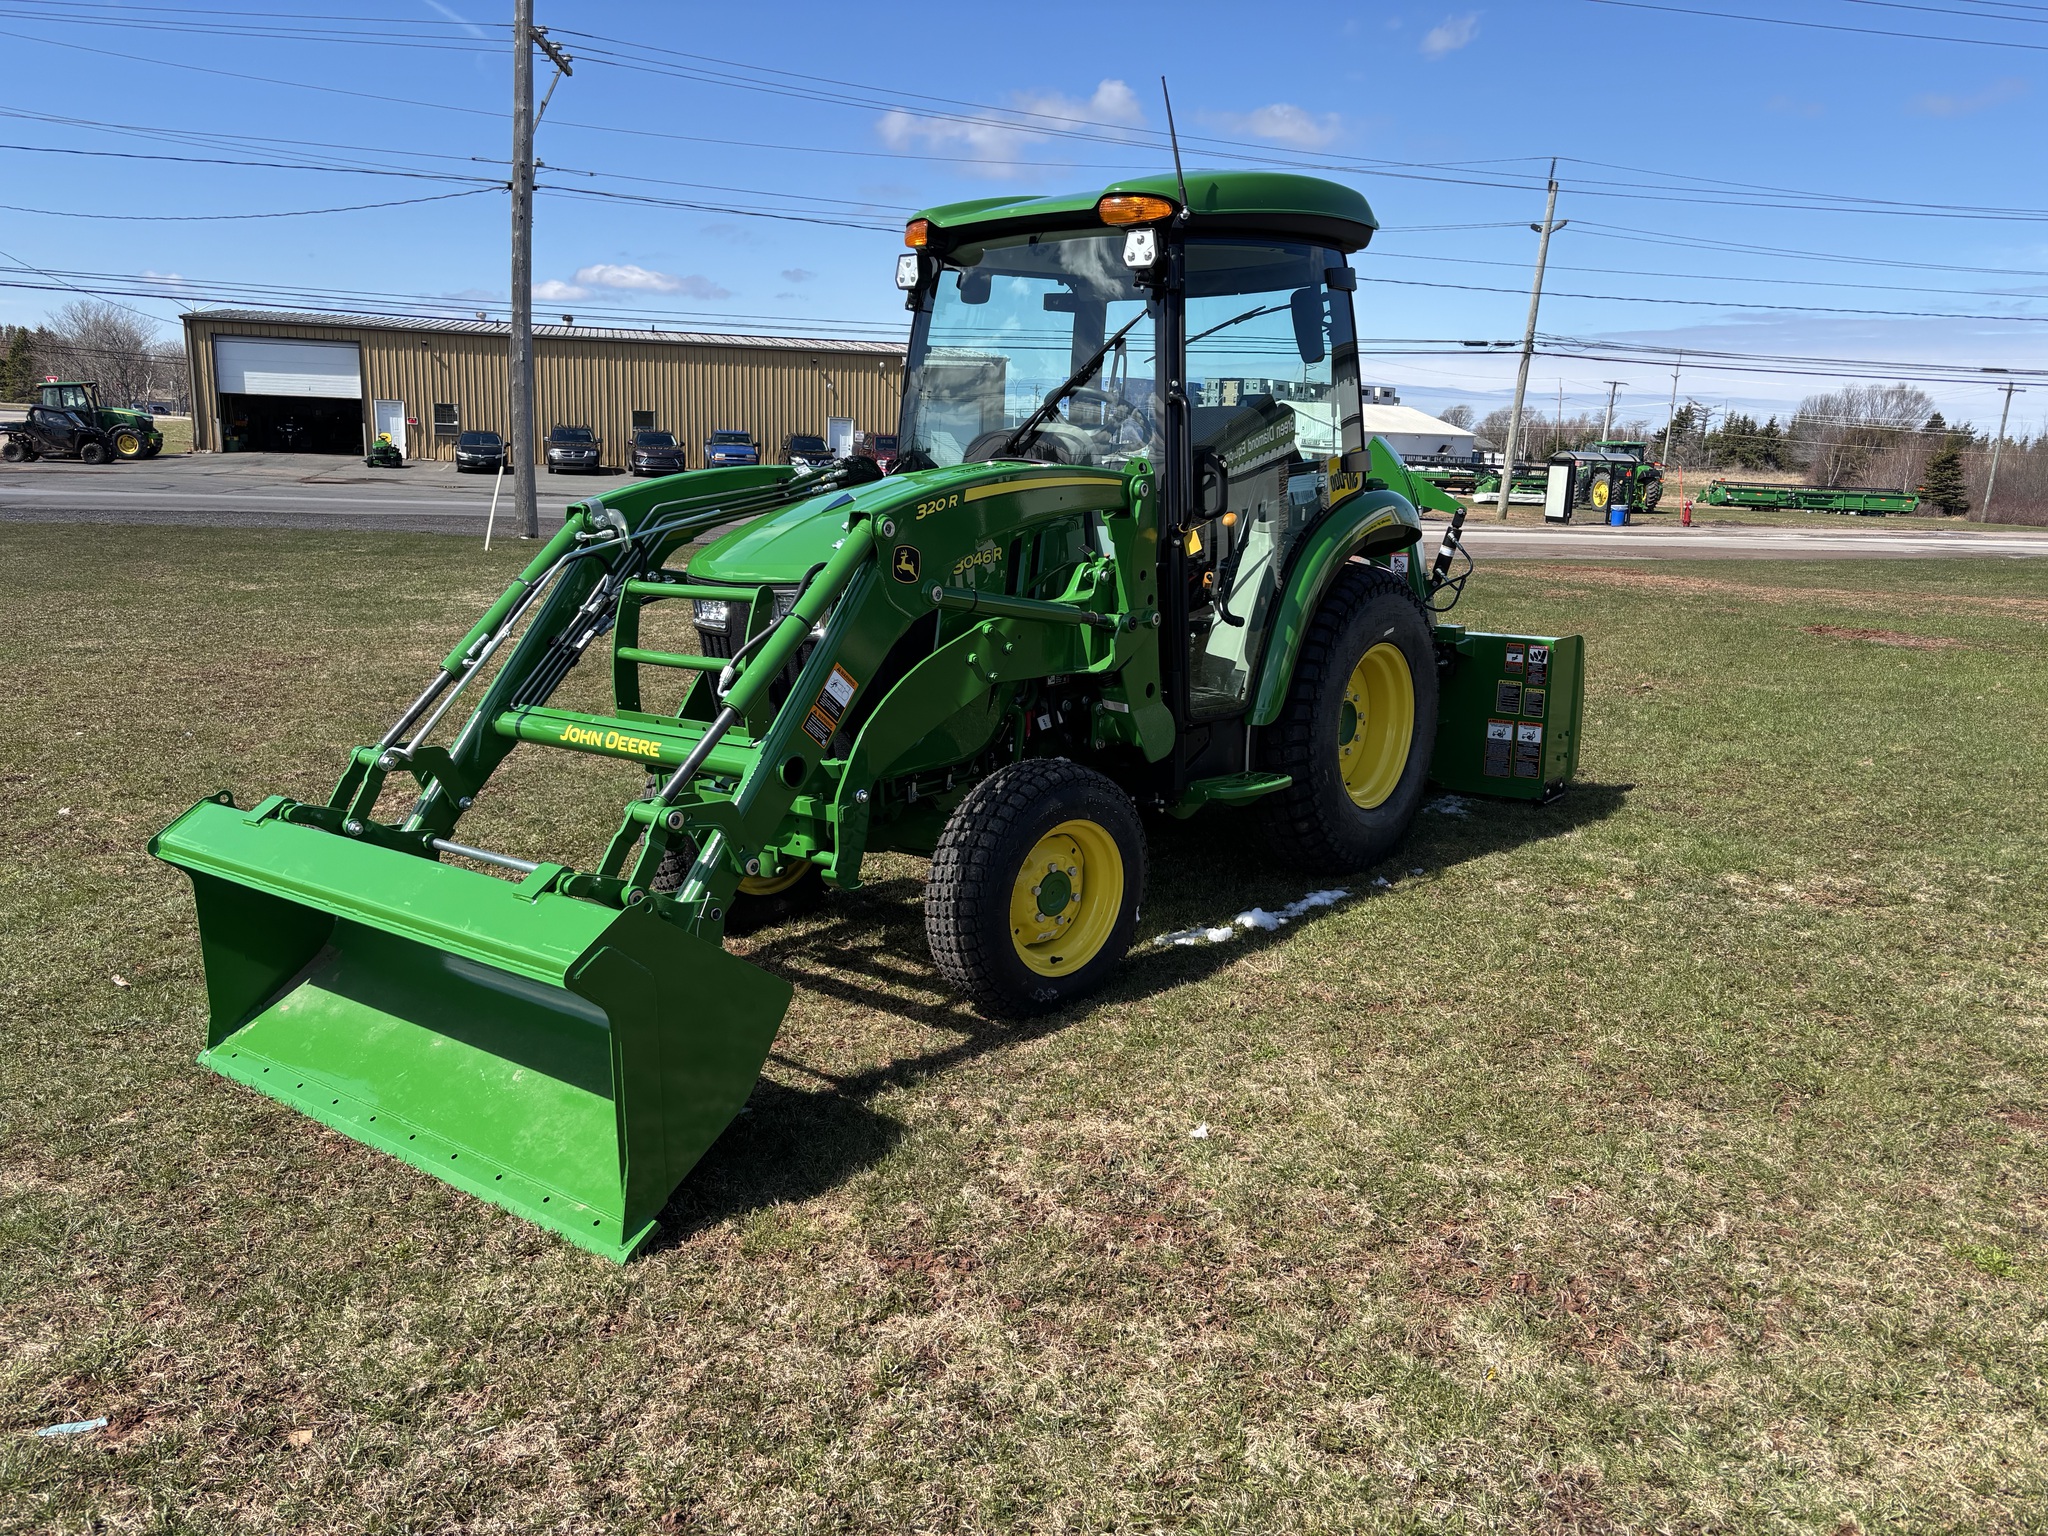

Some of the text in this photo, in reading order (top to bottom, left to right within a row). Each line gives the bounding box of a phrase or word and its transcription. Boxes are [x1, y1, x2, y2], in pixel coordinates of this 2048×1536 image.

[915, 494, 958, 520] 320 R
[953, 547, 1003, 575] 3046R
[560, 724, 662, 757] JOHN DEERE
